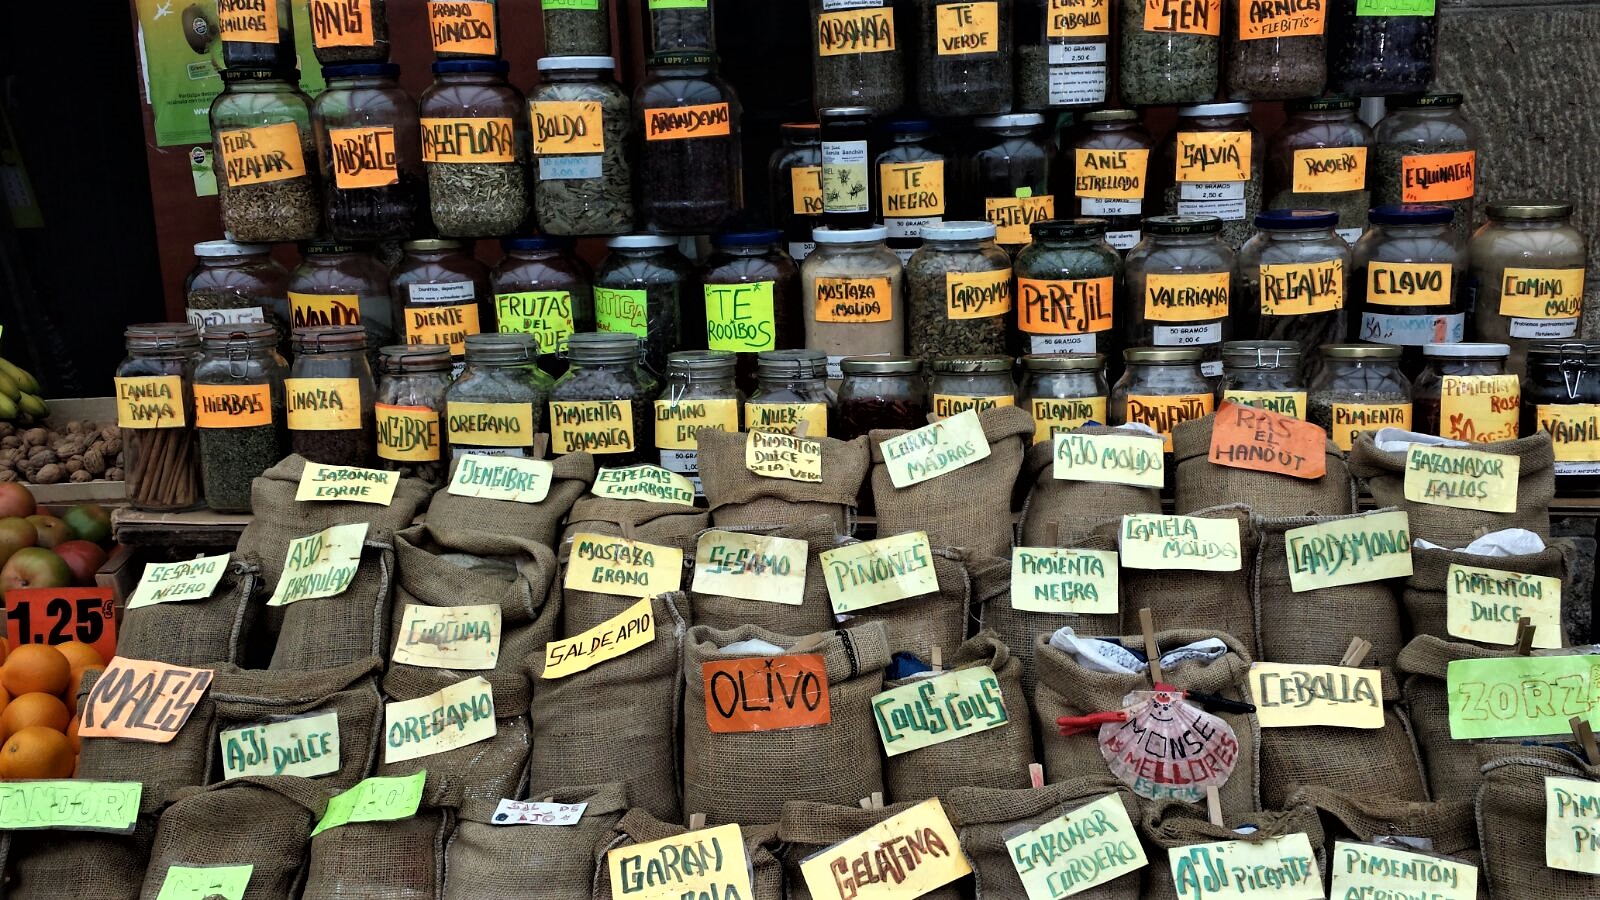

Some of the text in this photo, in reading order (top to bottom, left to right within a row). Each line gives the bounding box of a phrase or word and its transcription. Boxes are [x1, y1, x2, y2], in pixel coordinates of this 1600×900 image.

[942, 31, 990, 51] VERDE
[536, 112, 587, 143] BOLDO
[223, 131, 256, 155] FLOR
[227, 150, 293, 180] AZAHAR
[888, 192, 938, 210] NEGRO
[1373, 269, 1442, 295] CLAVO
[498, 295, 570, 319] FRUTAS
[712, 288, 752, 321] TE
[523, 318, 552, 330] DEL
[121, 382, 172, 401] CANELA
[129, 402, 176, 421] RAMA
[449, 414, 521, 433] OREGANO
[1254, 430, 1280, 447] EL
[907, 440, 976, 481] MADRAS
[1410, 450, 1504, 479] SAZONADOR
[1126, 518, 1198, 541] CANELA
[288, 534, 323, 571] AJO
[577, 540, 656, 567] MOSTAZA
[704, 545, 791, 577] SESAMO
[147, 561, 216, 583] SESAMO
[591, 565, 650, 587] GRANO
[151, 583, 206, 600] NEGRO
[1034, 581, 1099, 602] NEGRA
[1471, 602, 1522, 624] DULCE
[406, 619, 492, 647] CURCUMA
[546, 613, 650, 667] SAL DE APIO
[1260, 671, 1379, 708] CEBOLLA
[389, 693, 493, 747] OREGANO
[1121, 715, 1216, 760] MONSE
[272, 731, 331, 775] DULCE
[1125, 732, 1239, 784] MELLORES
[1015, 809, 1119, 873] SAZONAR
[1046, 840, 1137, 898] CORDERO
